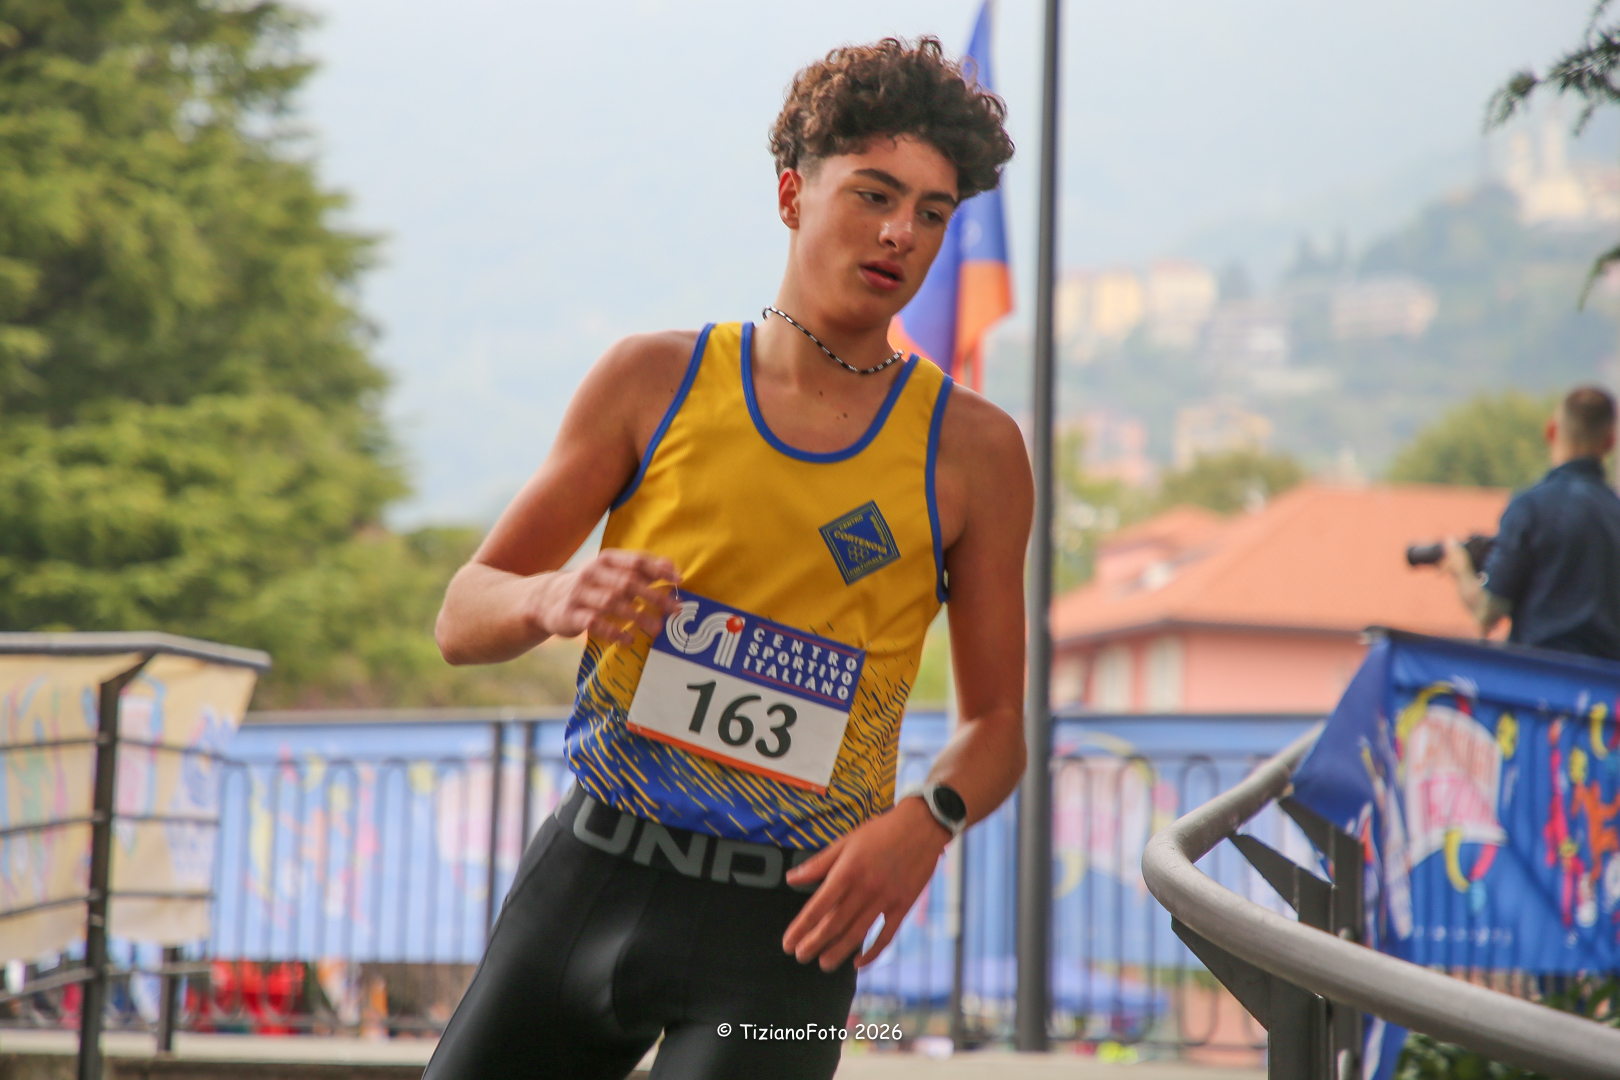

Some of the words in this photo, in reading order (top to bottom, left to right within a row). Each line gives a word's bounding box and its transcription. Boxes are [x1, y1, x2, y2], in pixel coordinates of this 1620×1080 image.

[748, 642, 853, 686] SPORTIVO
[753, 627, 858, 672] CENTRO
[743, 655, 849, 701] ITALIANO
[686, 679, 798, 759] 163
